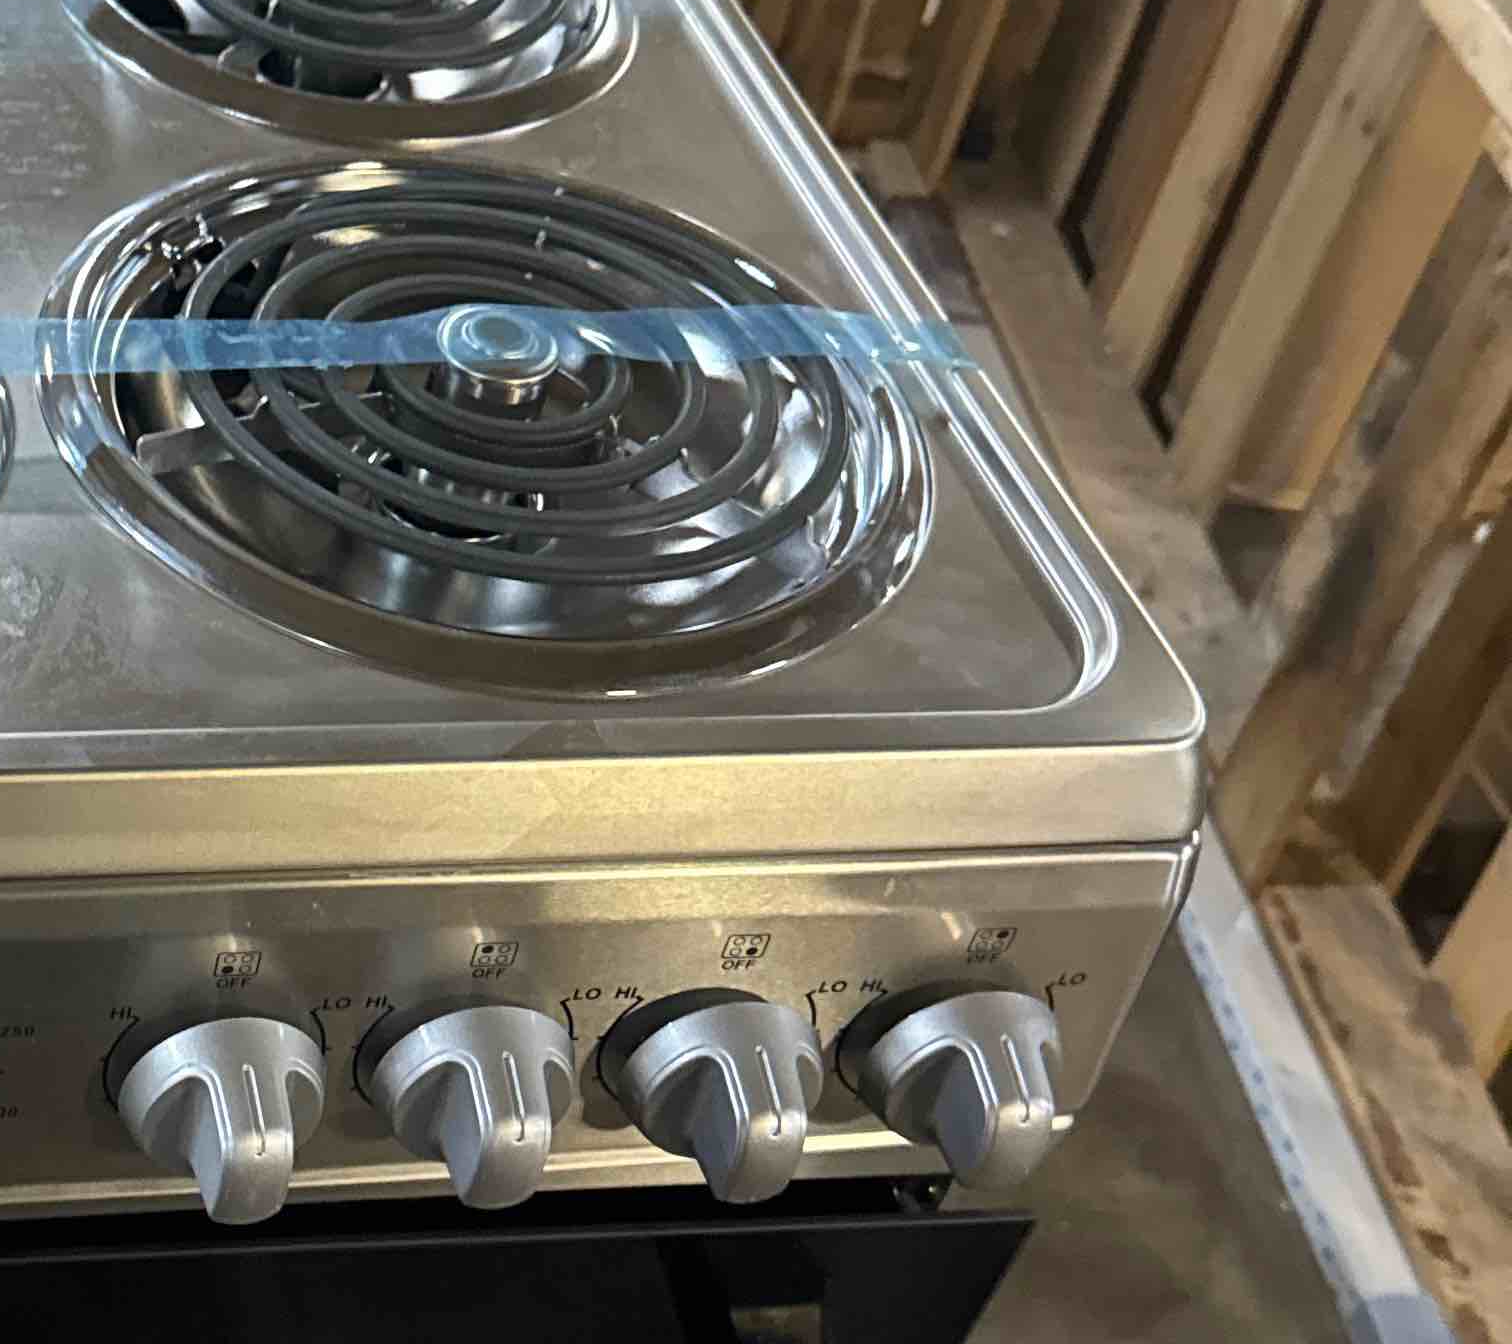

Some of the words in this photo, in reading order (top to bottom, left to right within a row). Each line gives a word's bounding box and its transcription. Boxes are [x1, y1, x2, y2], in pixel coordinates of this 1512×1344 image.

[720, 959, 756, 971] OFF
[472, 966, 506, 979] OFF
[216, 977, 252, 990] OFF
[110, 1006, 133, 1020] HI
[322, 997, 351, 1011] LO
[366, 996, 389, 1010] HI
[570, 987, 602, 1002] LO
[615, 986, 638, 1000] HI
[817, 979, 848, 994] LO
[859, 978, 883, 994] HI
[1055, 972, 1087, 986] LO
